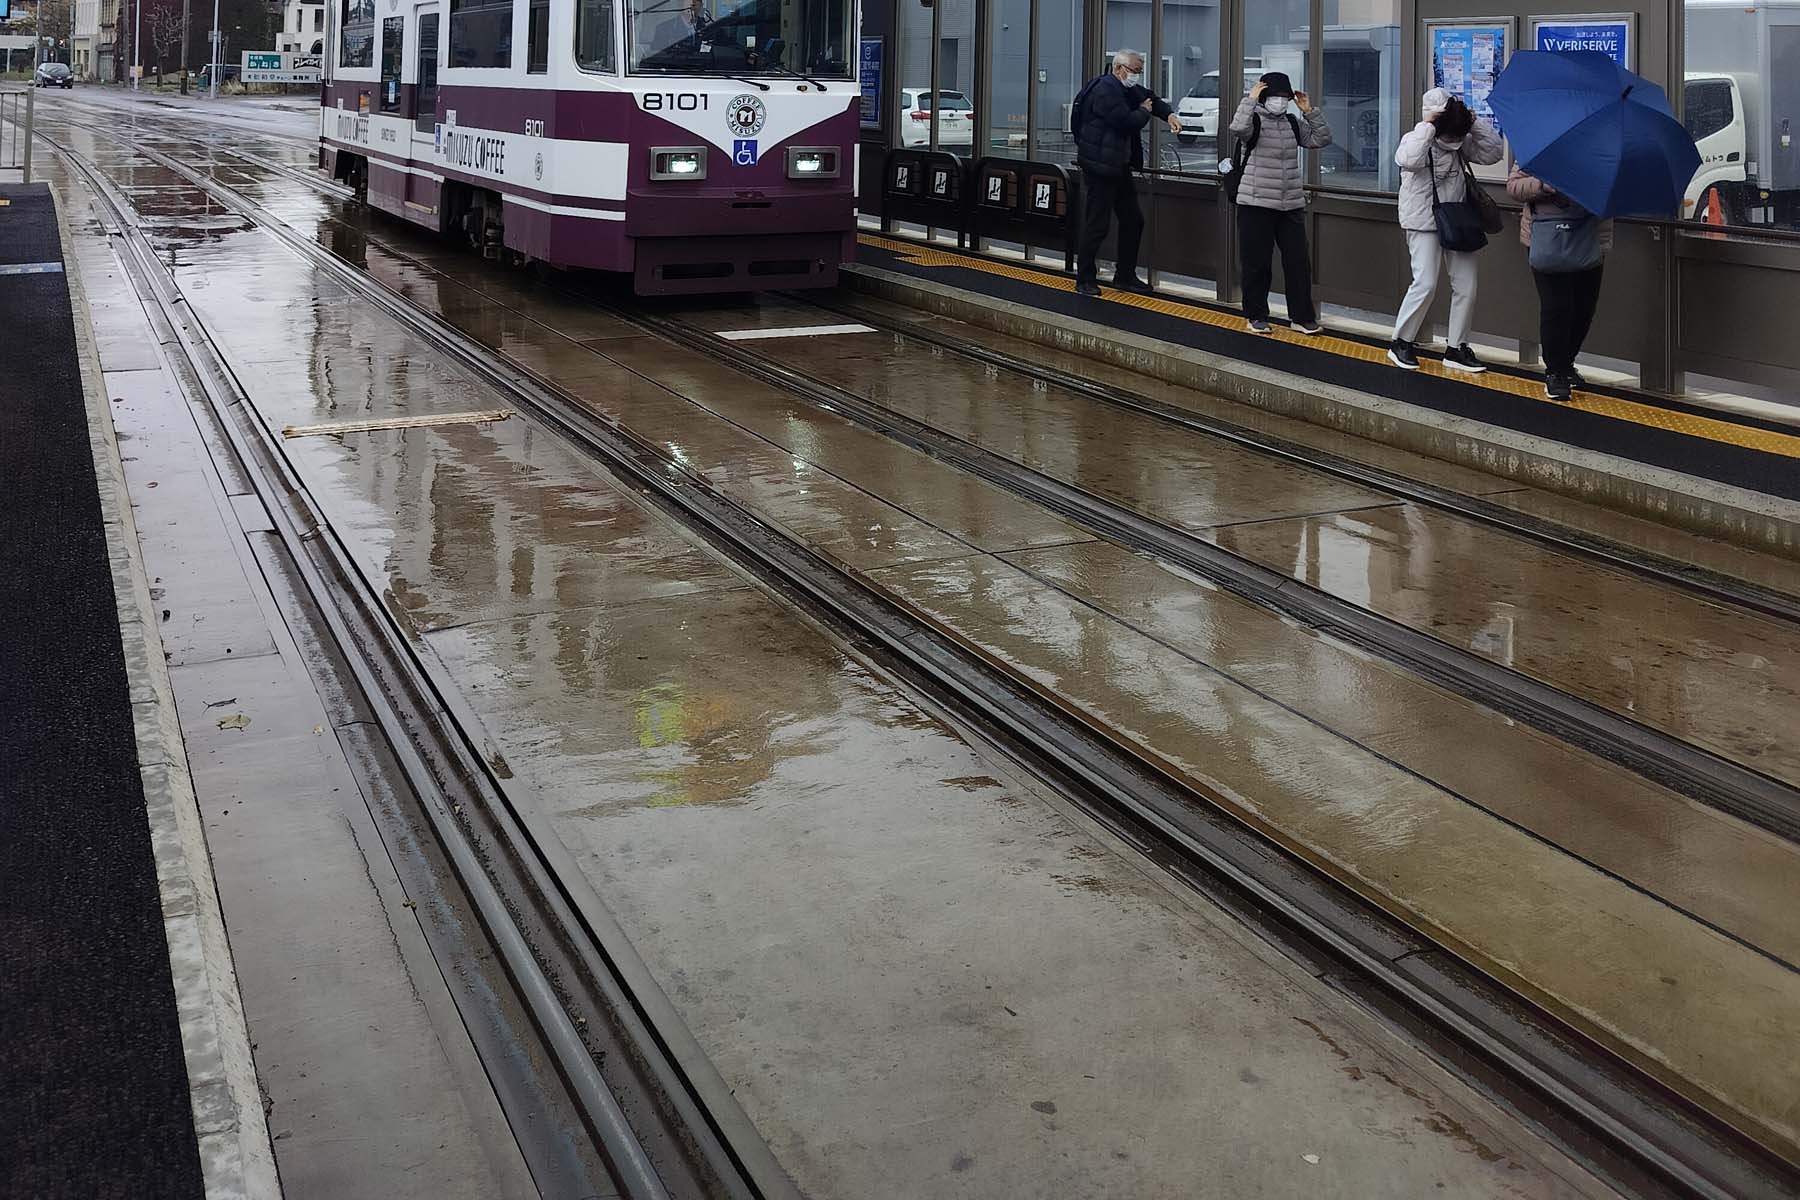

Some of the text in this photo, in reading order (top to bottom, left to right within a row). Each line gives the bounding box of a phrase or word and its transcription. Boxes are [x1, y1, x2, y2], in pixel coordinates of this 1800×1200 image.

[1557, 40, 1617, 51] VERISERVE
[643, 93, 708, 110] 8101
[732, 95, 761, 110] COFFEE
[525, 118, 544, 137] 8101
[731, 120, 761, 135] MISUZU
[447, 131, 473, 168] MISUZU
[475, 136, 505, 175] COFFEE
